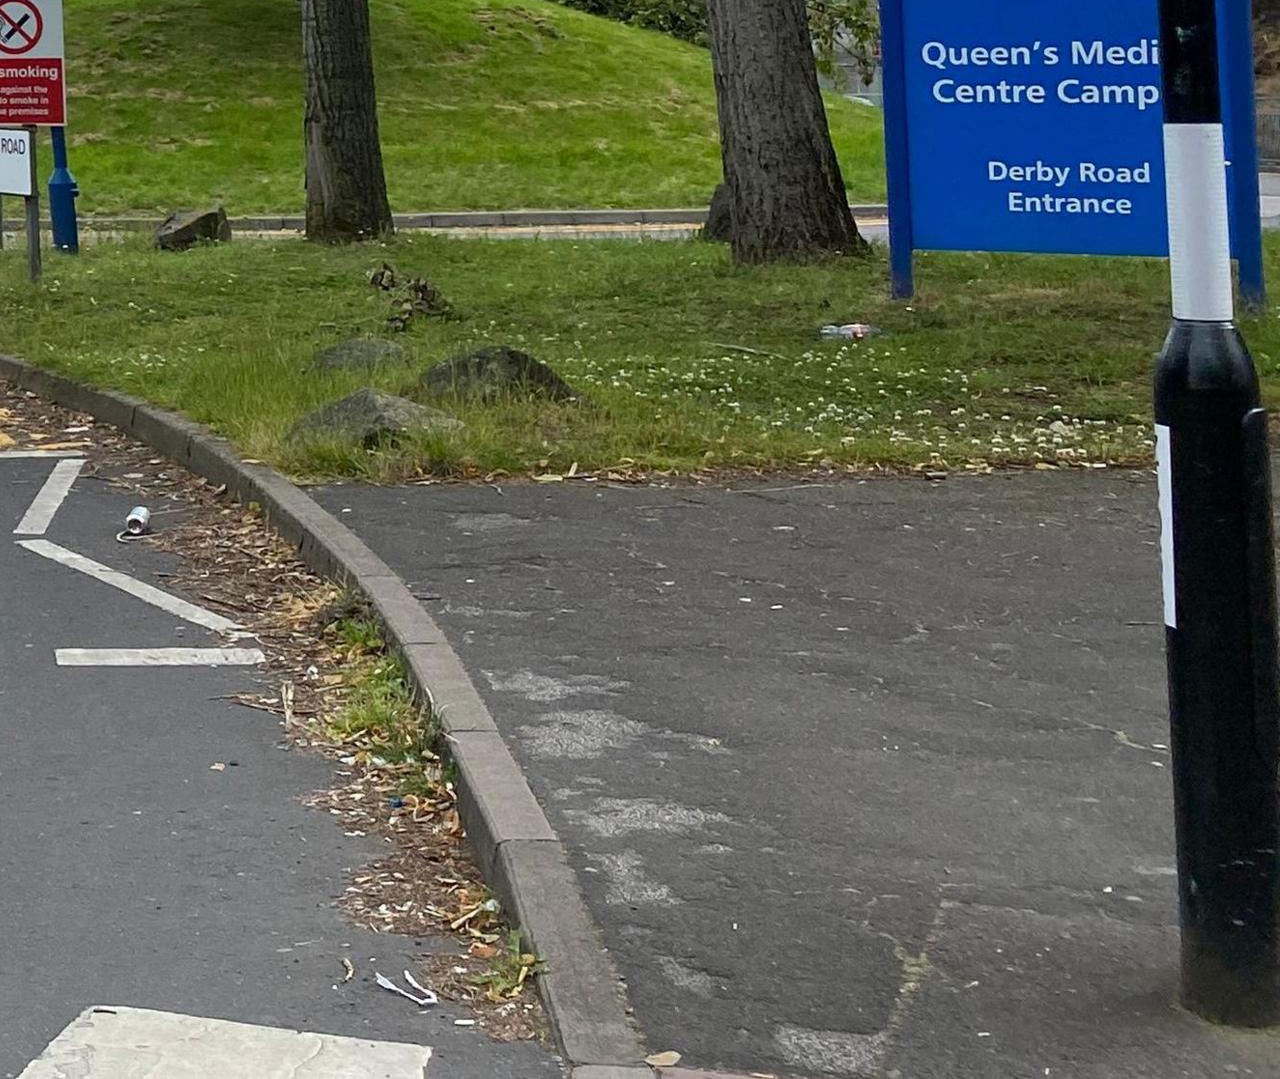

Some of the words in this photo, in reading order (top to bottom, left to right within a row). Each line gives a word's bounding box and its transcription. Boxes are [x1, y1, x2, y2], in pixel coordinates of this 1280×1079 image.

[921, 40, 1059, 69] Queen's
[1071, 39, 1160, 65] Medi
[0, 85, 32, 95] against
[34, 85, 48, 93] the
[932, 78, 1046, 104] Centre
[1056, 78, 1160, 110] Camp
[9, 96, 39, 104] smoke
[40, 96, 49, 104] in
[8, 107, 49, 117] premises
[1, 138, 26, 155] ROAD
[988, 161, 1070, 187] Derby
[1079, 162, 1151, 183] Road
[1008, 192, 1132, 214] Entrance
